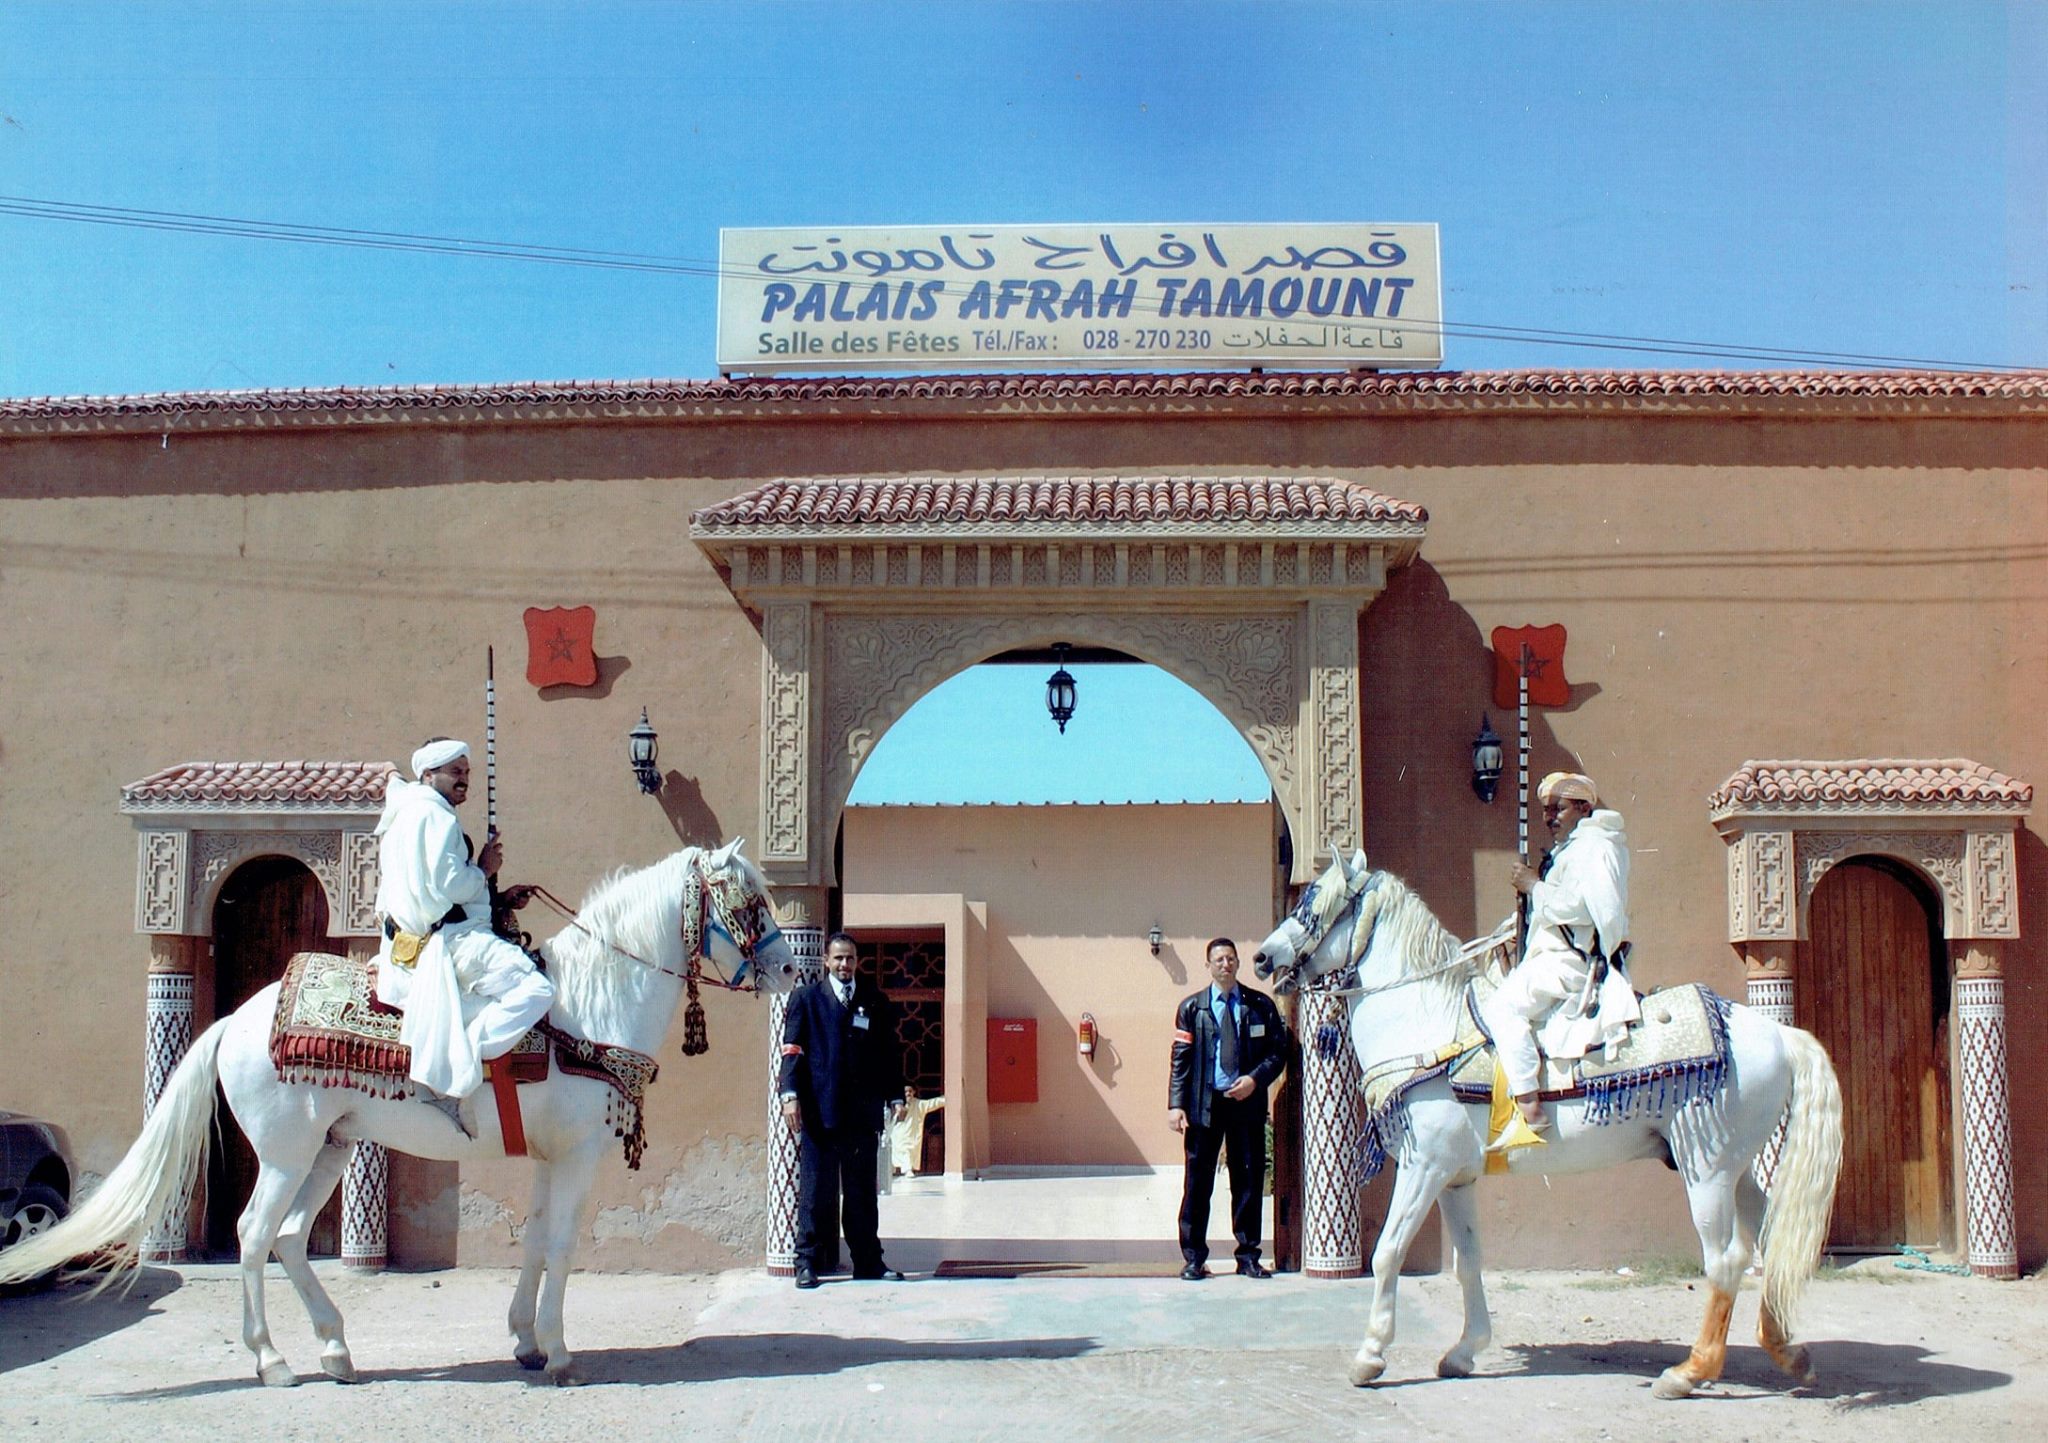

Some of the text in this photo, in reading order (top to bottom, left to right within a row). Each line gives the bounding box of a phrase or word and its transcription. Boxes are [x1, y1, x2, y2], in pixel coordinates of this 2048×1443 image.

[1241, 231, 1407, 275] قصر
[760, 276, 1415, 324] PALAIS AFRAH TAMOUNT
[758, 330, 960, 355] Salle des Fêtes
[972, 329, 1048, 352] Tél./Fax
[1083, 329, 1119, 351] 028
[1135, 329, 1171, 350] 270
[1175, 329, 1212, 350] 230
[1222, 325, 1403, 349] قاعة الحفلات
